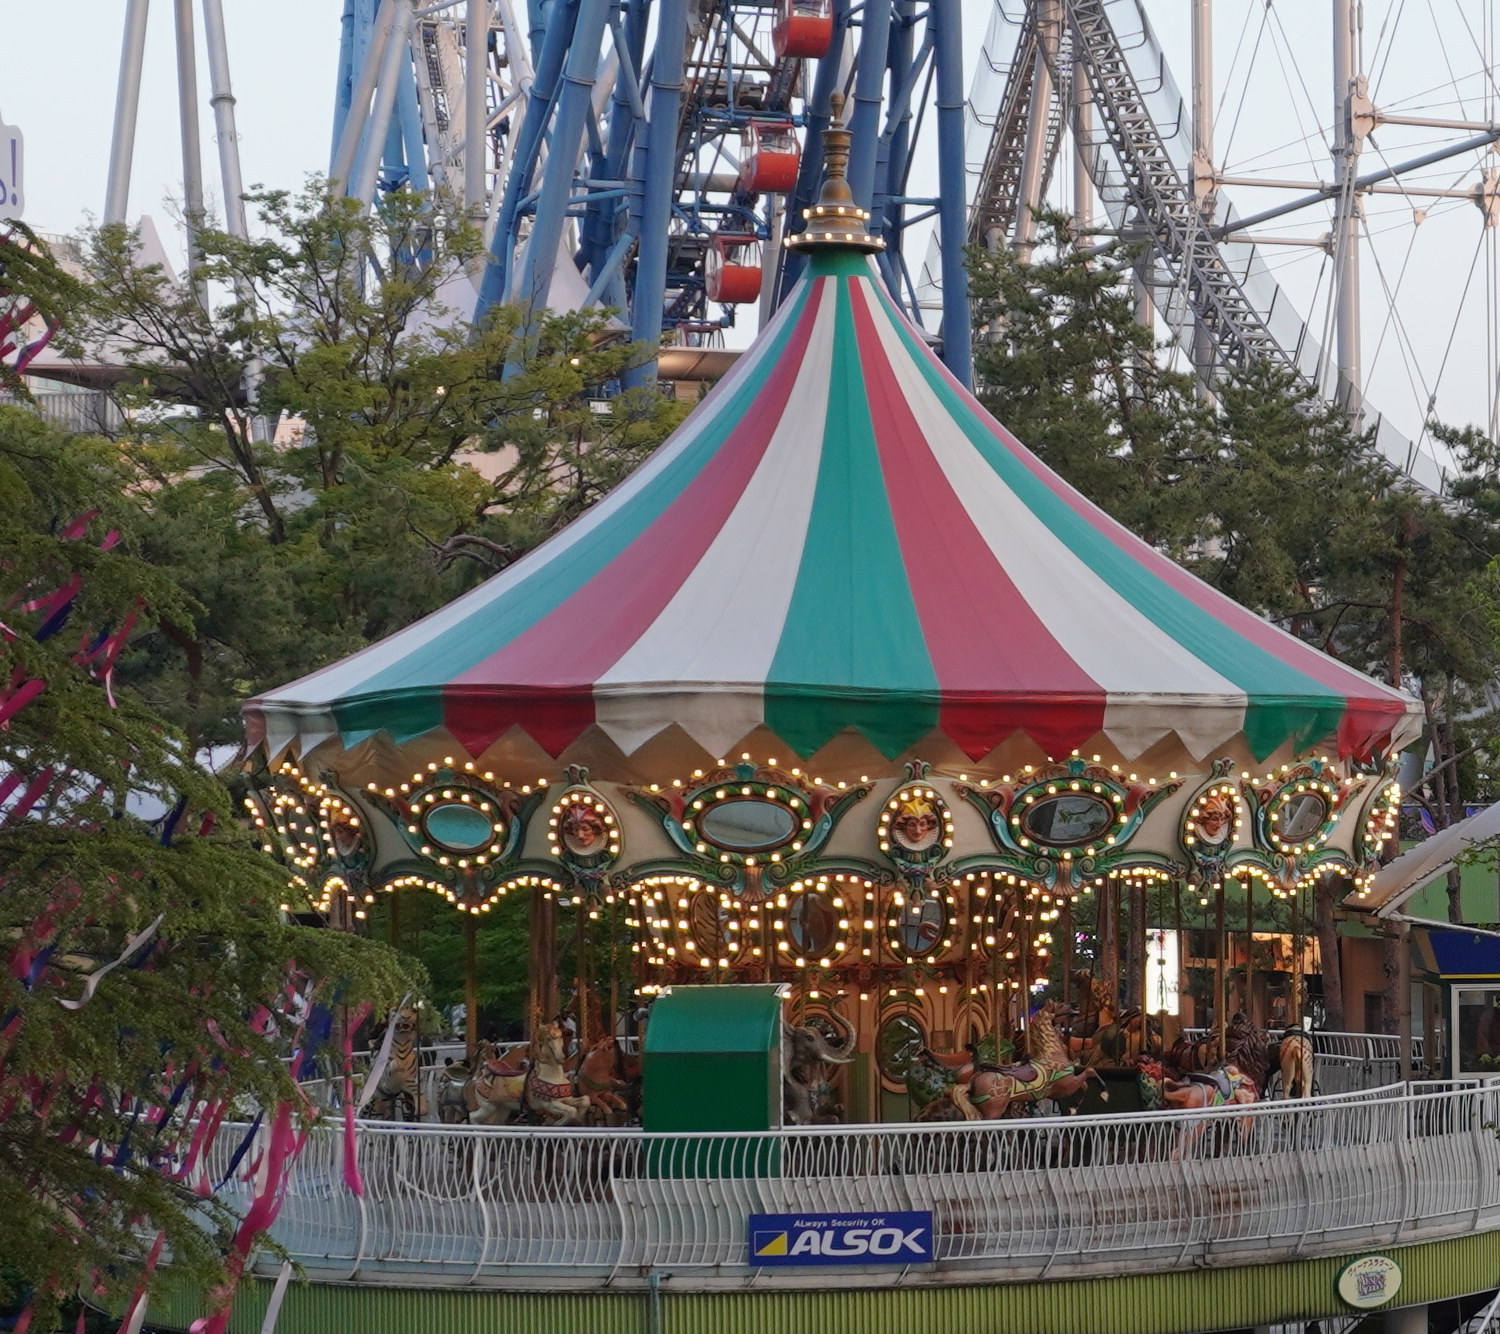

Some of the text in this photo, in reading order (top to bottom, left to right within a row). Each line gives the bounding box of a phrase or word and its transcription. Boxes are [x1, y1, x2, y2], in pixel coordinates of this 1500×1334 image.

[831, 1218, 869, 1228] Security
[871, 1218, 886, 1227] OK
[789, 1228, 927, 1256] ALSOK
